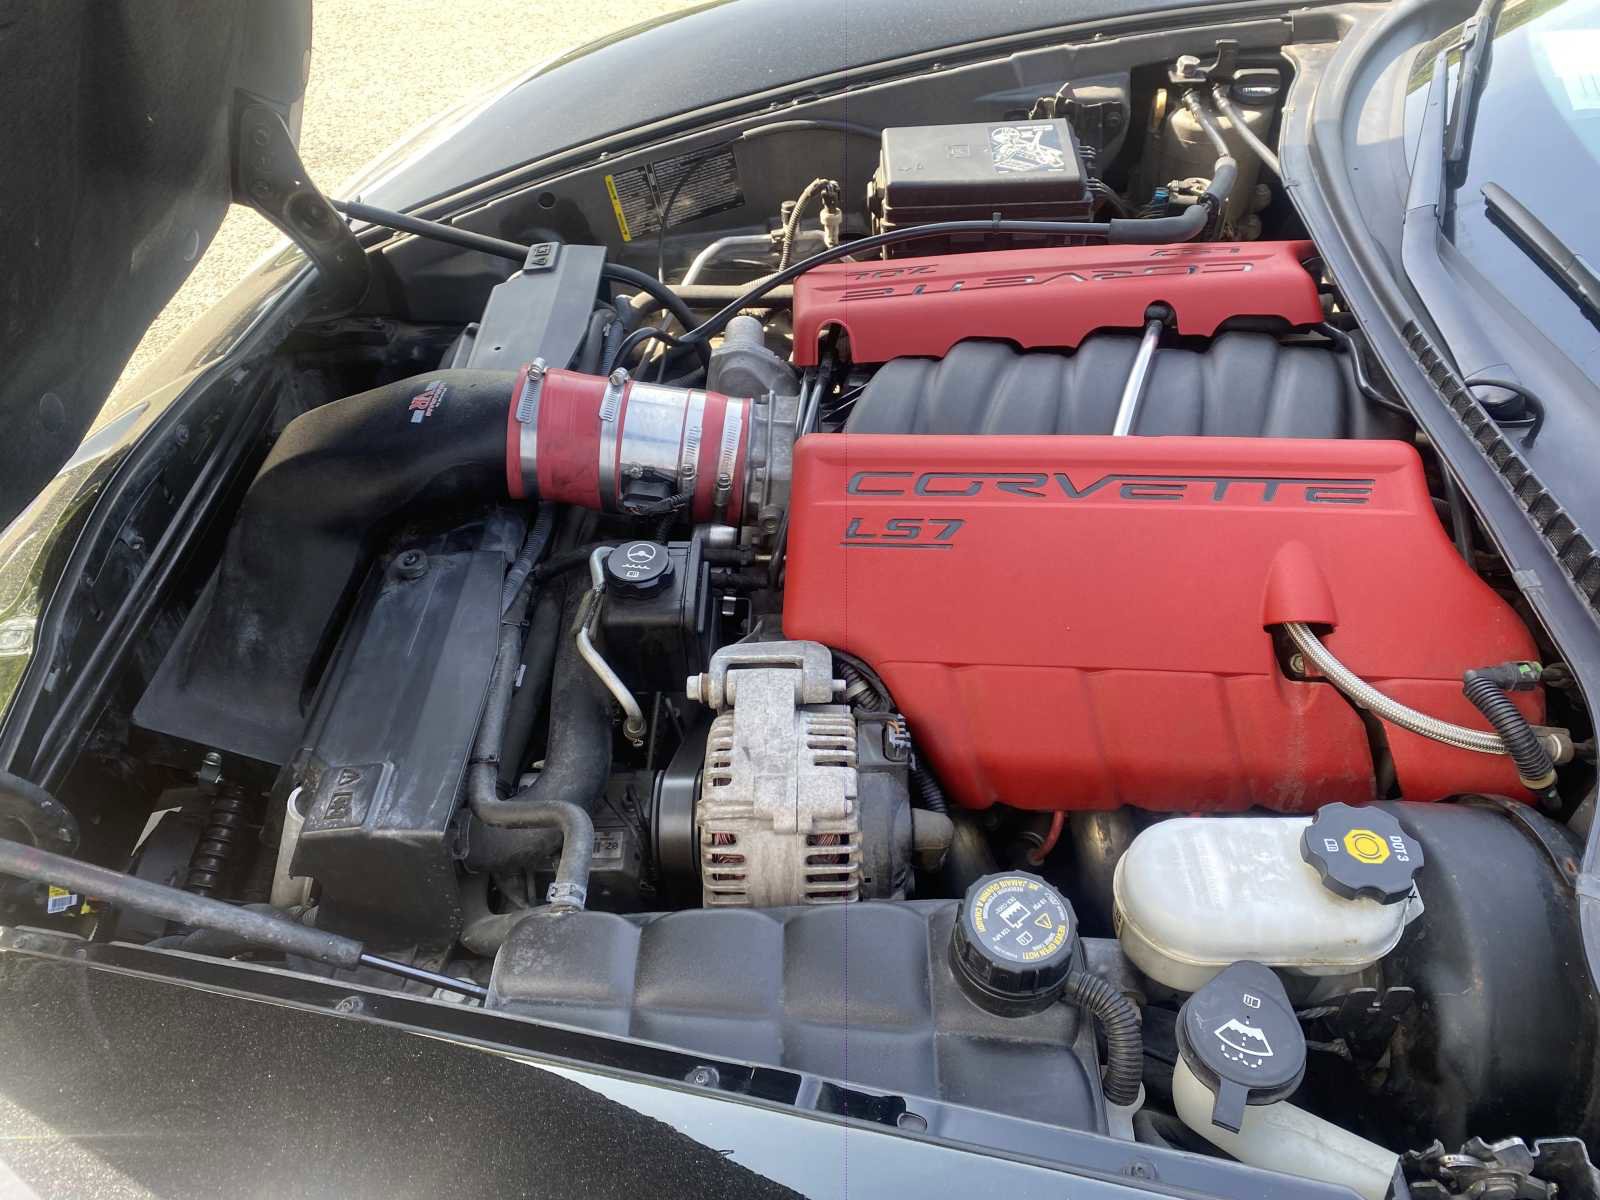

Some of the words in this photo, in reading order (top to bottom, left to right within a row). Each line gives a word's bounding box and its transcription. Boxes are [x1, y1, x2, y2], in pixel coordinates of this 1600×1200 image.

[838, 262, 1254, 301] CORVETTE
[848, 471, 1376, 504] CORVETTE
[845, 517, 966, 540] LS7
[1389, 835, 1408, 855] DOT
[1397, 854, 1410, 862] 3
[1022, 951, 1041, 960] HOT!
